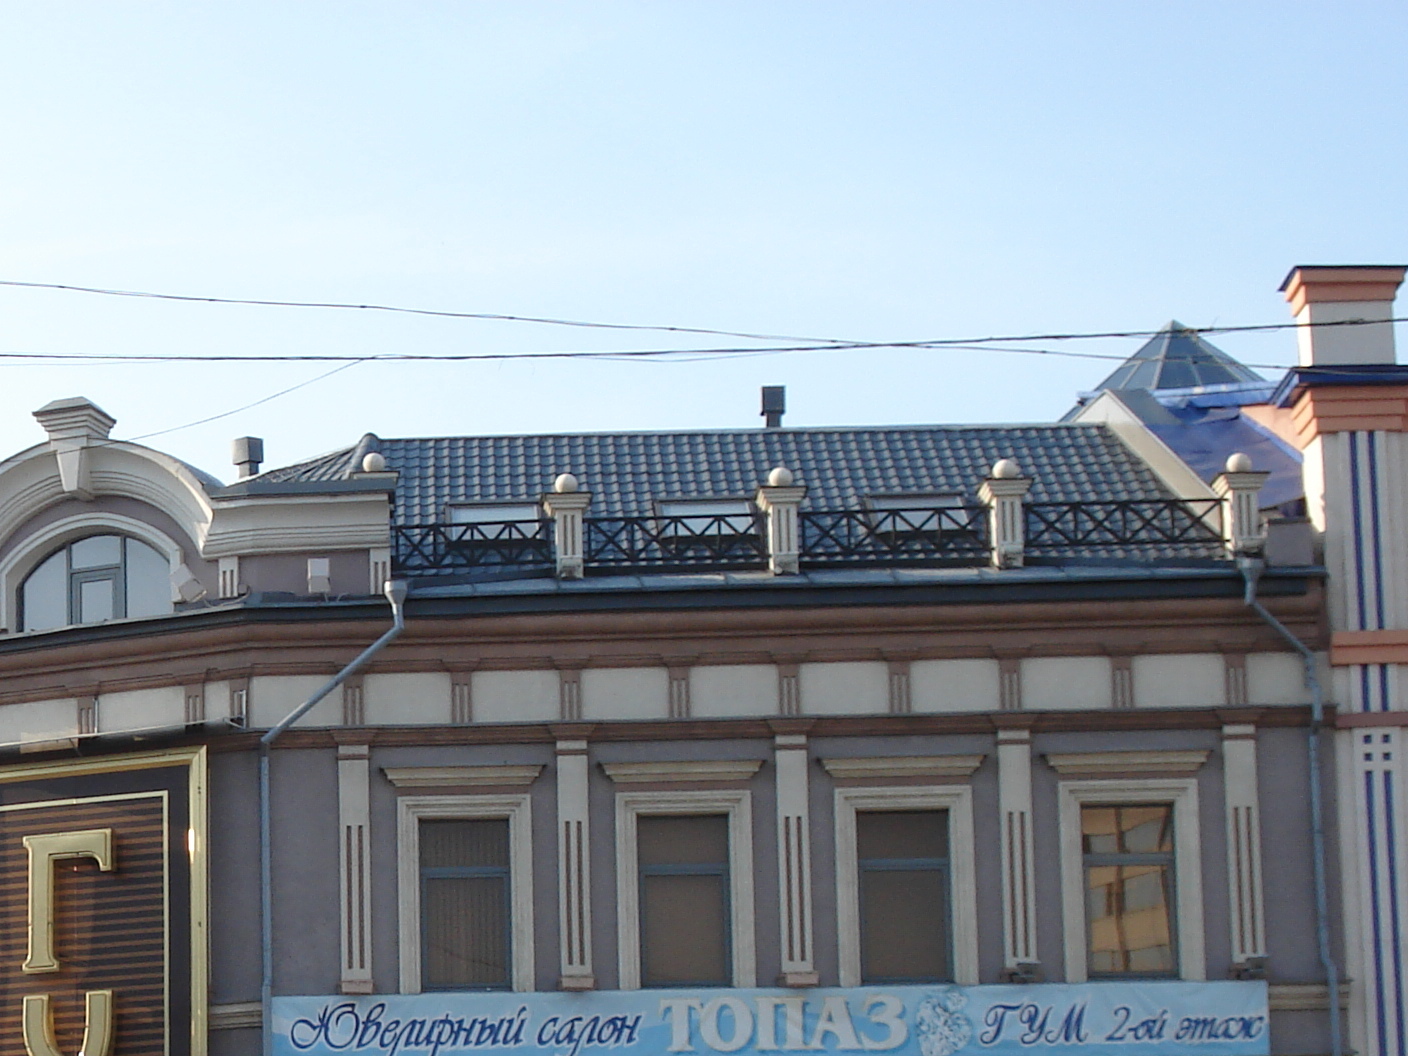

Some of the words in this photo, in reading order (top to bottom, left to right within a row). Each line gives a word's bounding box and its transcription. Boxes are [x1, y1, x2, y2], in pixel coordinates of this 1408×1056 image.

[659, 995, 908, 1053] ТОПАЗ
[979, 1002, 1089, 1046] ГУМ
[1104, 1006, 1169, 1042] 2-ой
[1174, 1014, 1266, 1042] этаж
